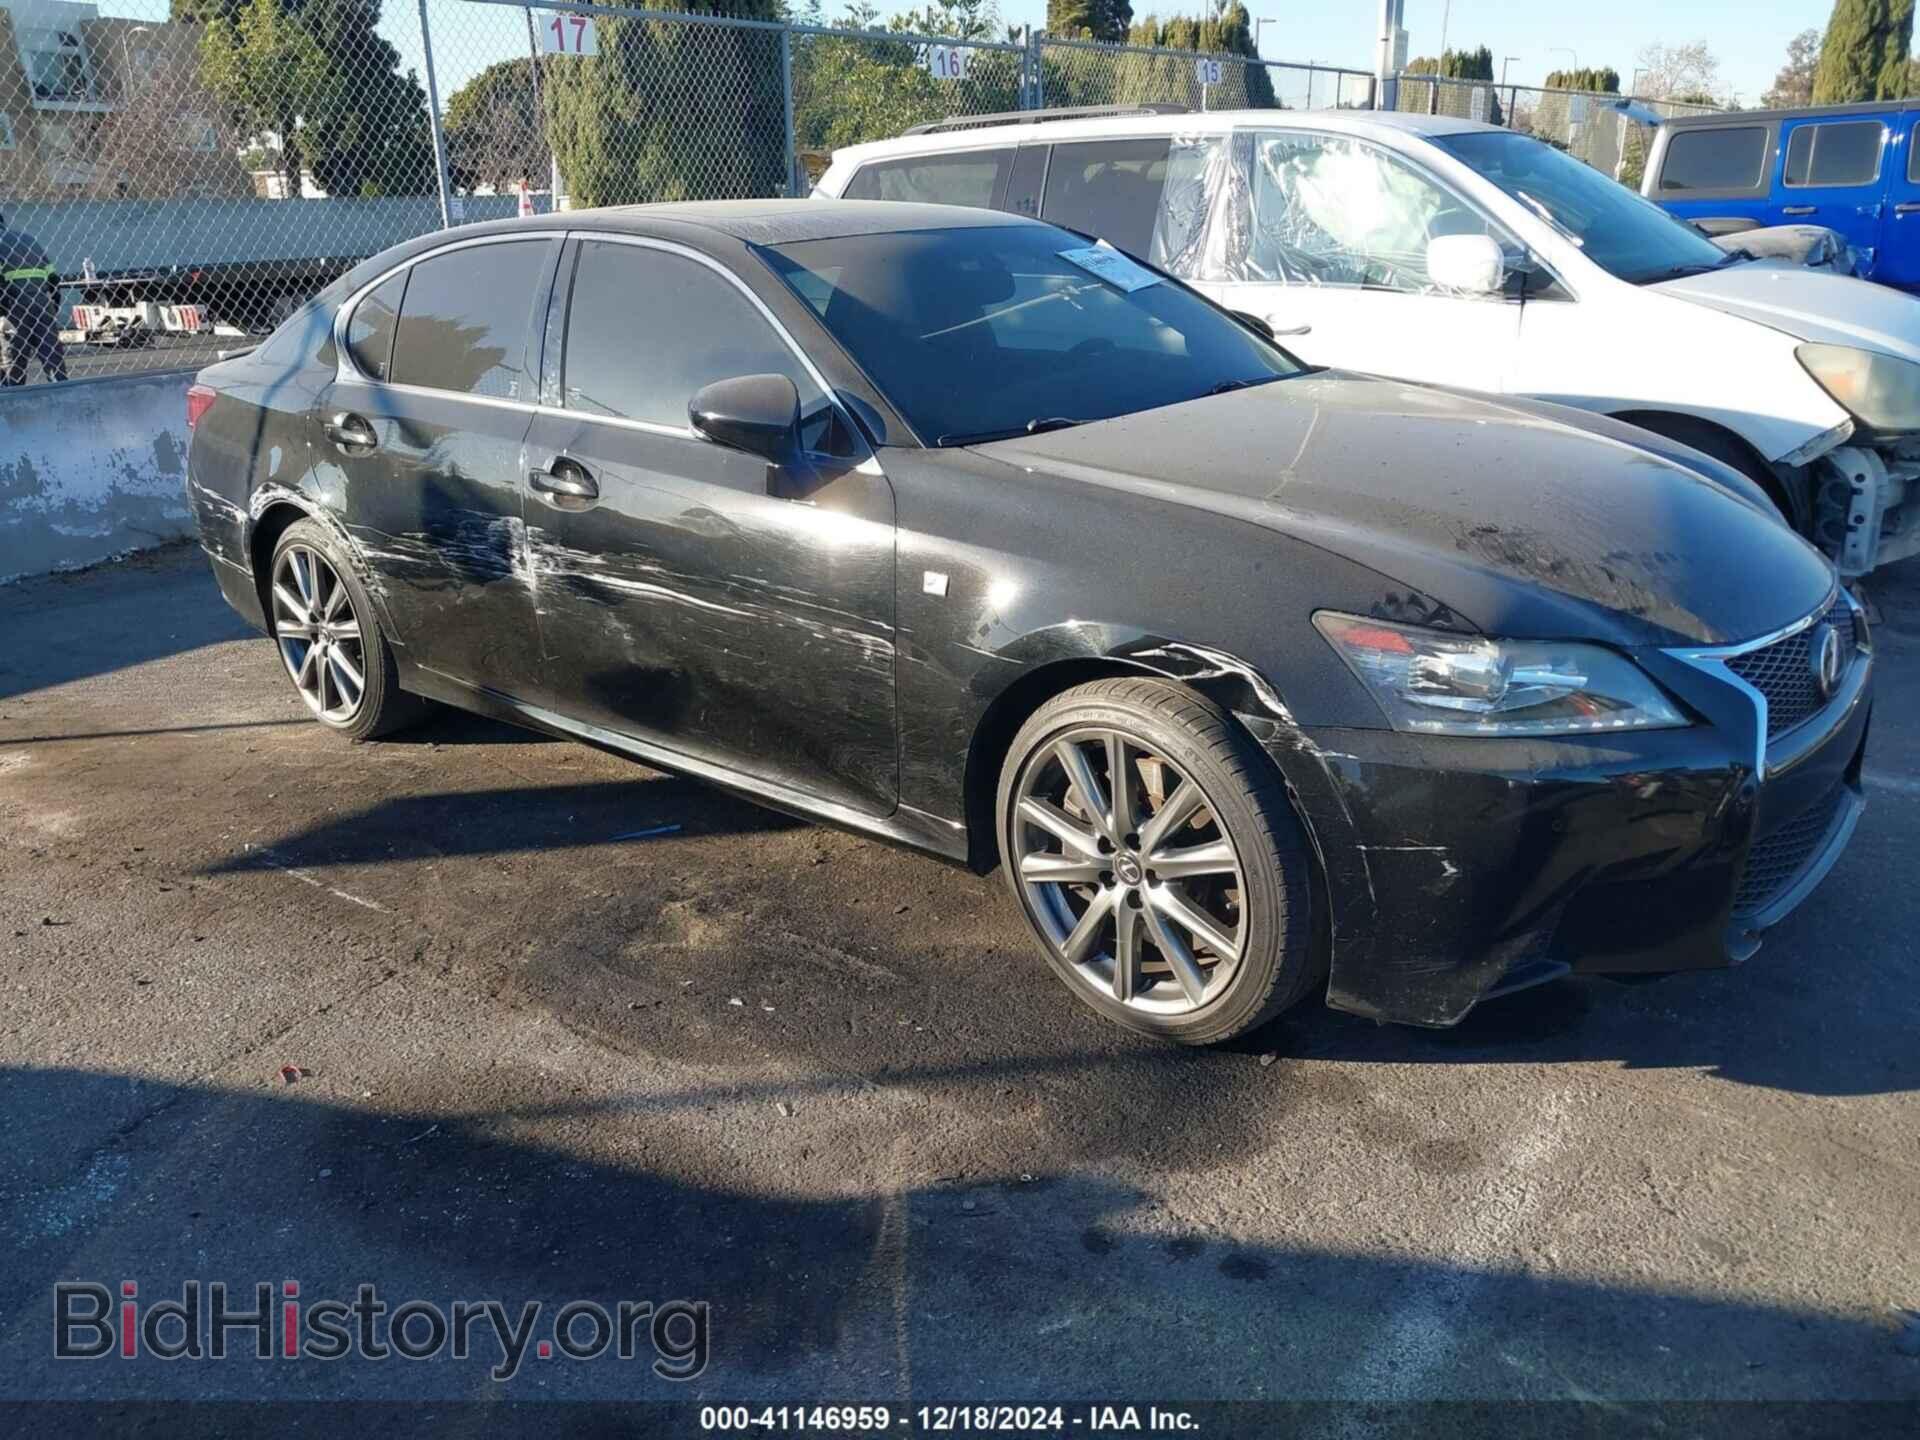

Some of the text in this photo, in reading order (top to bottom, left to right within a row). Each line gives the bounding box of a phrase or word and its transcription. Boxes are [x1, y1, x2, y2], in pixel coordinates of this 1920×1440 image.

[551, 17, 586, 52] 17
[937, 51, 960, 77] 16
[1203, 62, 1217, 82] 15
